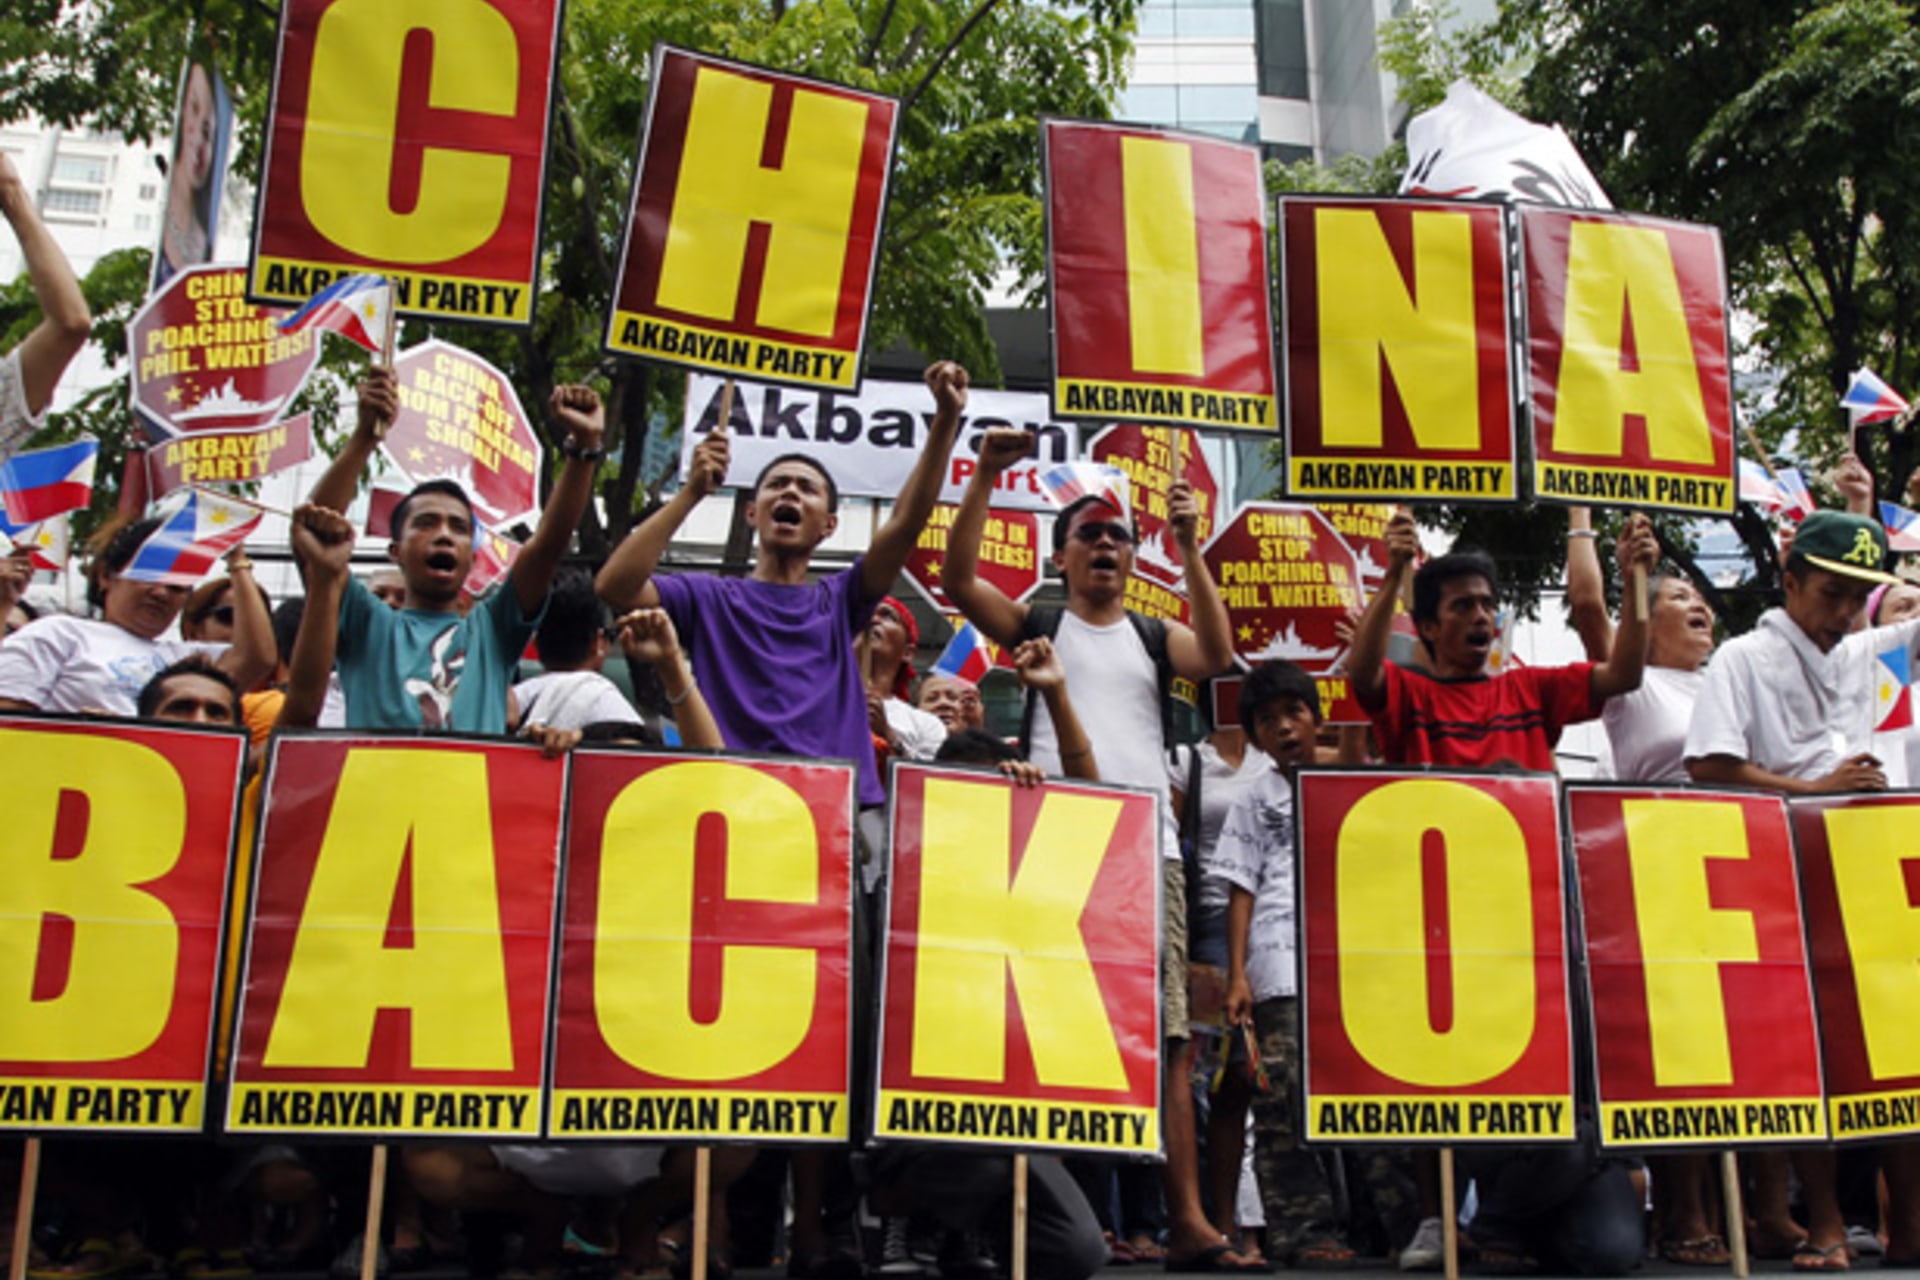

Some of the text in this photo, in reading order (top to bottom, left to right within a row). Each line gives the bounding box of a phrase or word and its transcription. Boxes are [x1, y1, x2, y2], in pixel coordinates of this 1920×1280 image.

[300, 0, 519, 264] C
[656, 66, 869, 339] H
[1121, 136, 1204, 377] I
[186, 272, 247, 299] CHIN
[264, 264, 520, 316] AKBN PARTY
[147, 316, 277, 353] POACHING
[621, 319, 846, 381] AKBAYAN PARTY
[1314, 207, 1481, 450] N
[1552, 220, 1715, 466] A
[141, 328, 312, 384] PHIL. WATERS!
[1066, 383, 1268, 424] AKBAYAN PARTY
[166, 426, 287, 468] AKBAYAN
[398, 385, 534, 475] ROM PANATAG
[426, 418, 500, 475] SHOAL!
[181, 452, 271, 484] PARTY
[952, 457, 1049, 501] Prt
[1299, 463, 1504, 493] AKBAYAN PARTY
[1543, 468, 1727, 508] AKBAYAN PARTY
[1331, 513, 1387, 541] SHOA
[1259, 538, 1311, 561] STOP
[1221, 561, 1348, 584] POACHING IN
[1218, 585, 1268, 608] PHIL.
[262, 748, 514, 1071] A
[594, 761, 819, 1080] C
[911, 777, 1131, 1092] K
[1336, 779, 1536, 1087] O
[1621, 799, 1760, 1087] F
[0, 1086, 191, 1124] AN PARTY
[239, 1090, 530, 1128] AKBAYAN PARTY
[561, 1097, 838, 1134] AKBAYAN PARTY
[888, 1098, 1147, 1145] AKBAYAN PARTY
[1318, 1102, 1563, 1134] AKBAYAN PARTY
[1612, 1103, 1817, 1140] AKBAYAN PARTY
[1839, 1095, 1919, 1131] AKBAY
